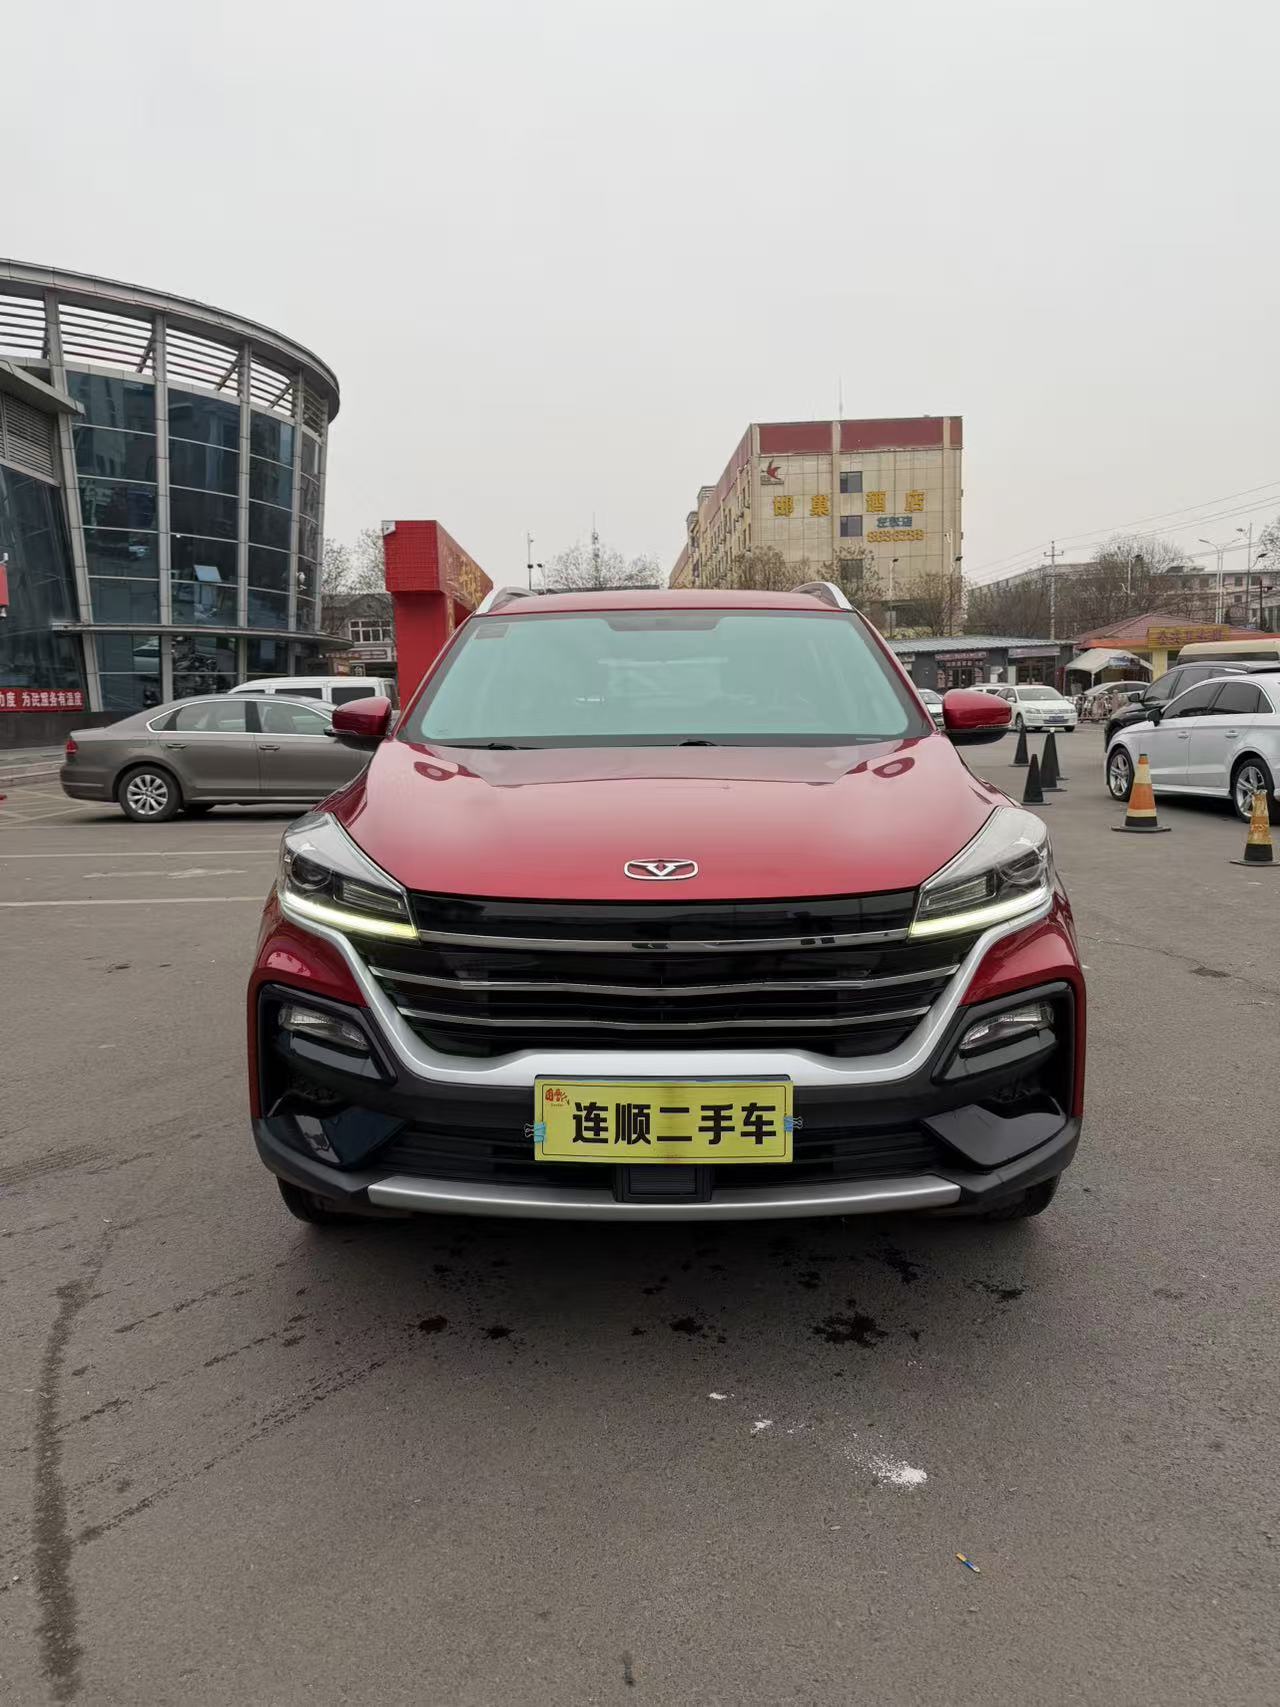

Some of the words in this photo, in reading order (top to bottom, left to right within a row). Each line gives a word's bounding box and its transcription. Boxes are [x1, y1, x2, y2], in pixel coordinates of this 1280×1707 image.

[22, 691, 83, 707] 为民服务有温度
[572, 1101, 777, 1146] 连顺二手车
